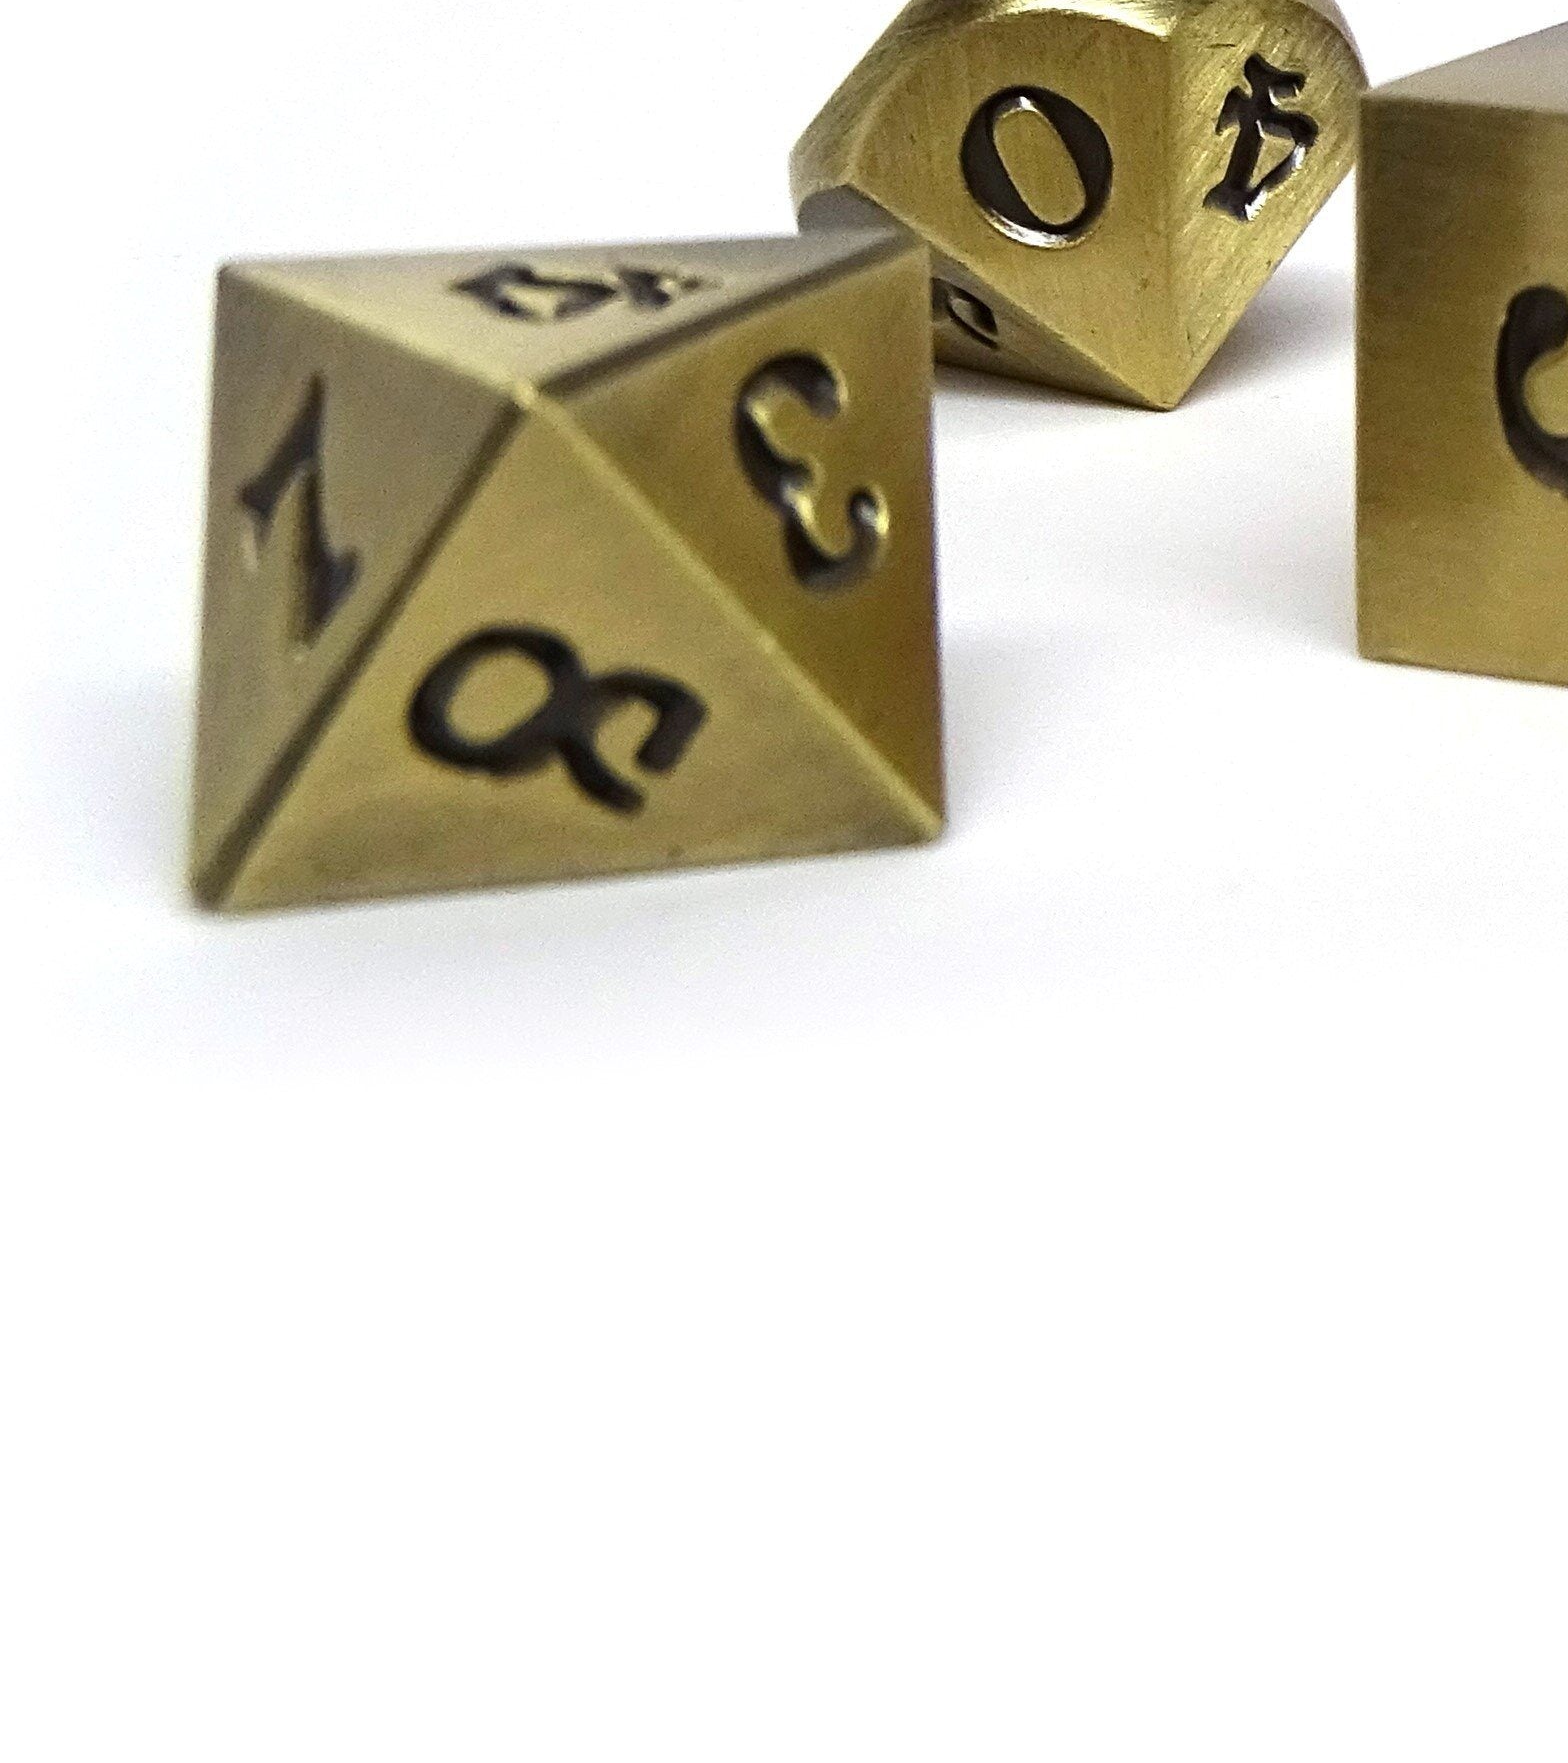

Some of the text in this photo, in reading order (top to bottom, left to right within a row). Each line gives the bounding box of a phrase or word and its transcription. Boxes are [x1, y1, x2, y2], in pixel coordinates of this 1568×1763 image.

[959, 85, 1113, 250] 0
[1203, 54, 1319, 223] 4
[734, 349, 889, 588] 3
[408, 624, 709, 816] 8
